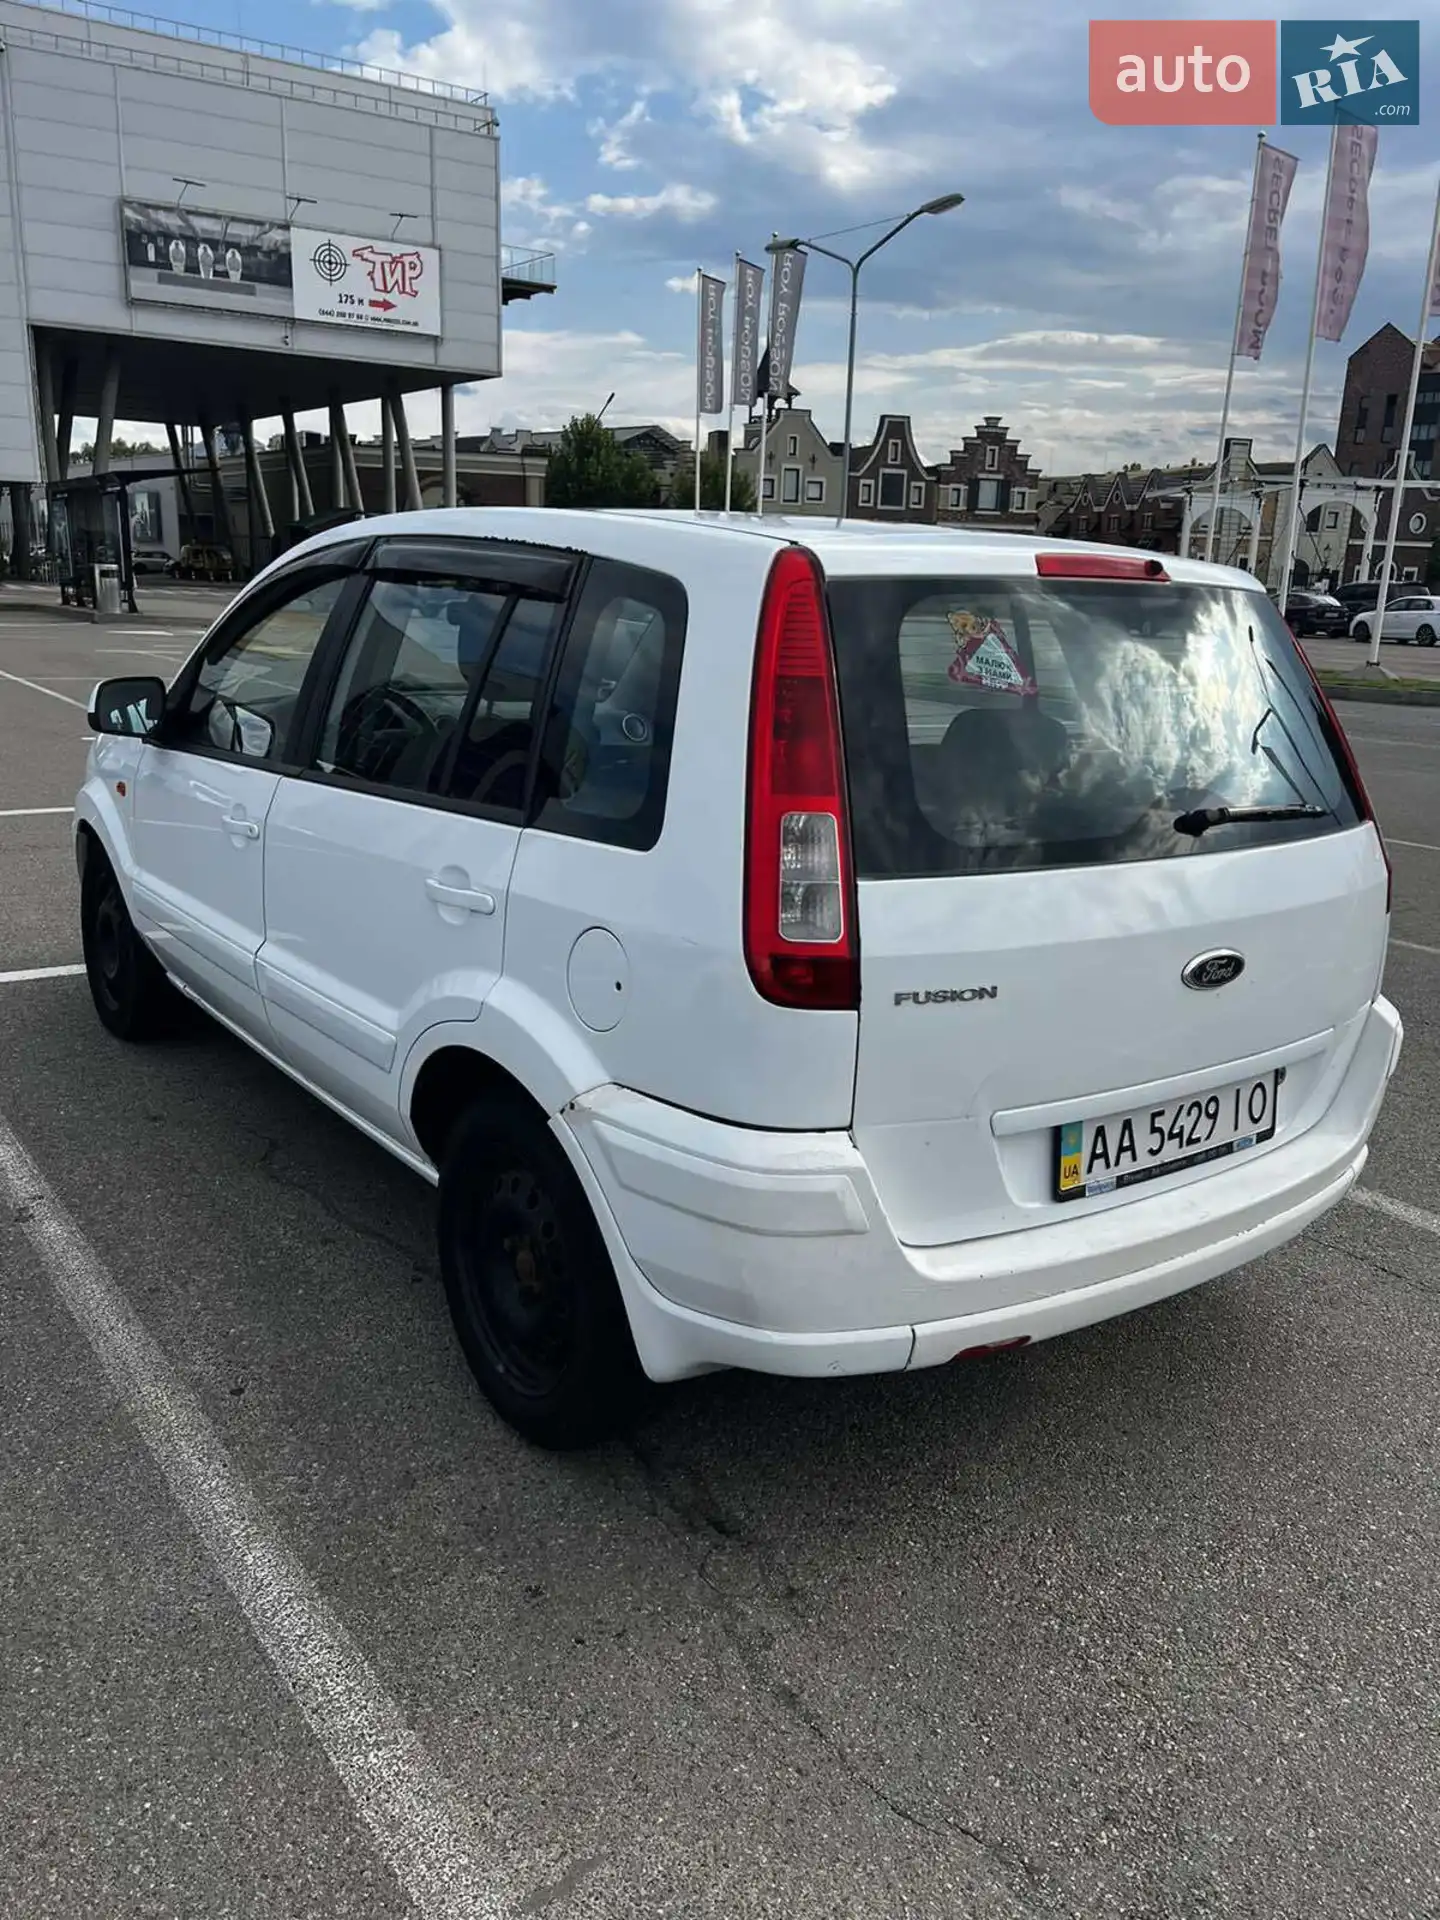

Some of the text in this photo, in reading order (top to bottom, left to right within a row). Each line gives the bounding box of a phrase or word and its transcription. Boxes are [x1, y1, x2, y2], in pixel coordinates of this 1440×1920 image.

[338, 293, 355, 305] 175
[1202, 957, 1235, 982] Ford
[894, 985, 998, 1006] FUSION
[1086, 1117, 1138, 1174] AA
[1147, 1095, 1220, 1156] 5429
[1063, 1164, 1079, 1179] UA
